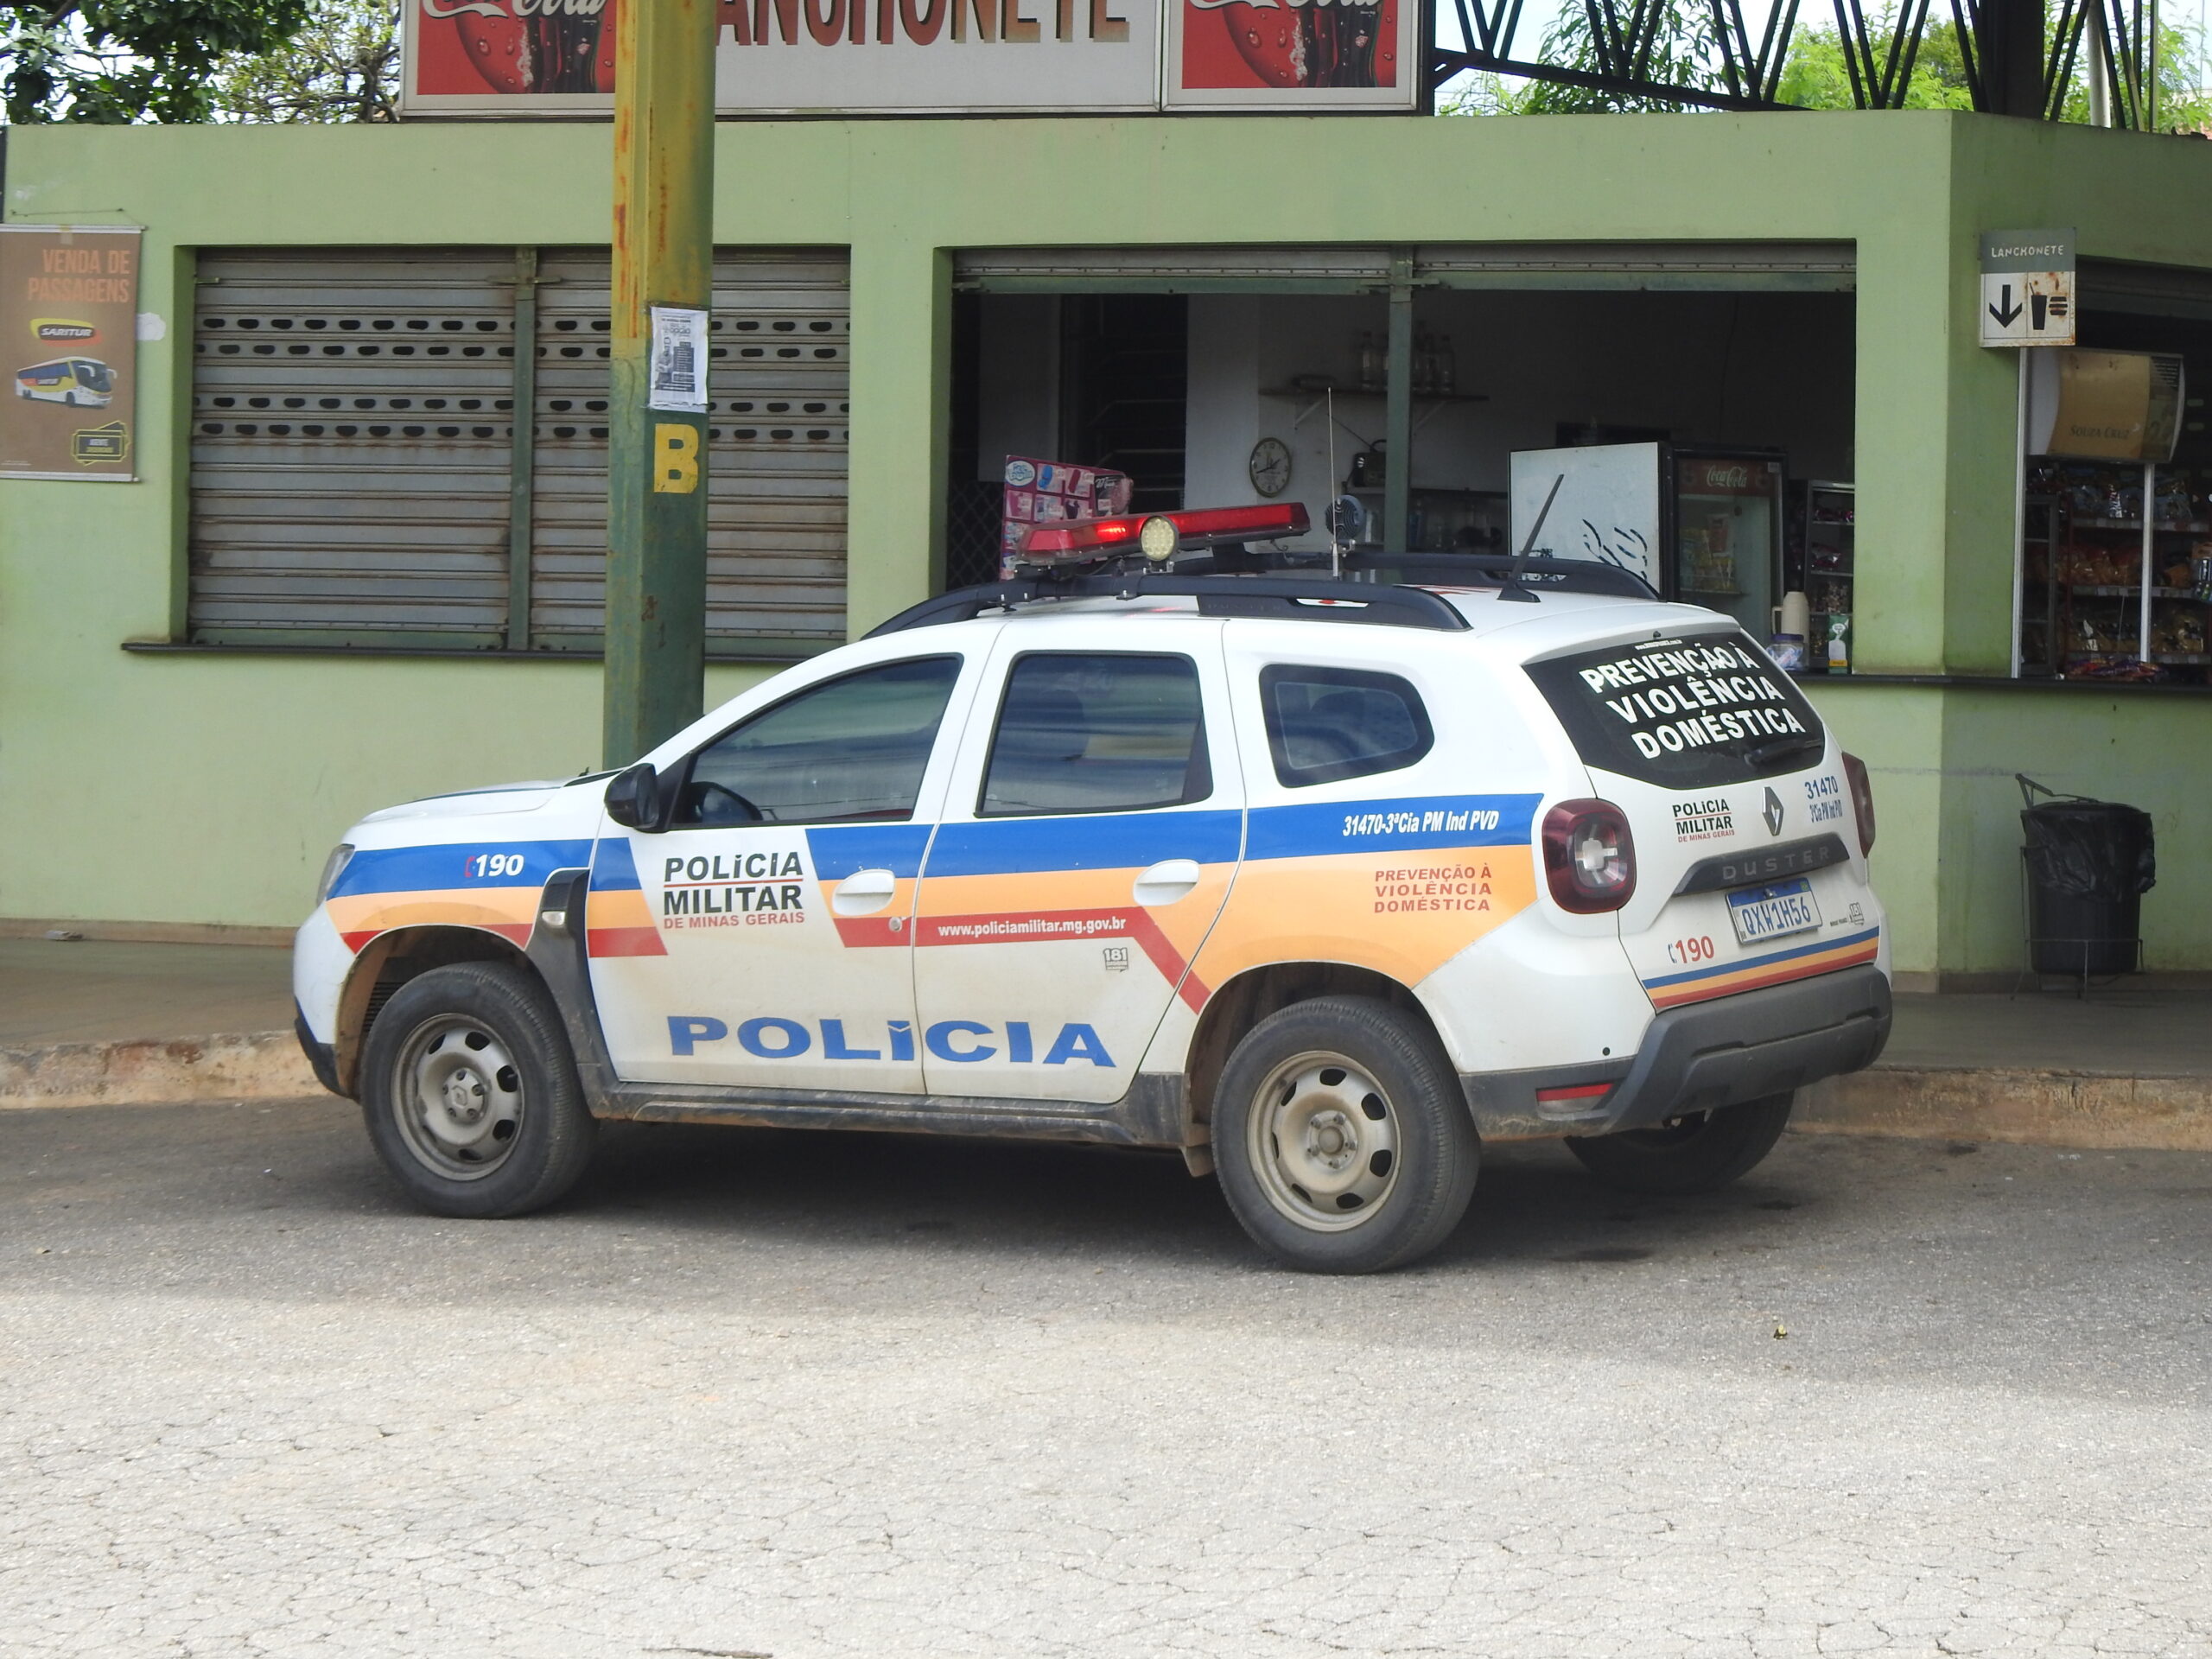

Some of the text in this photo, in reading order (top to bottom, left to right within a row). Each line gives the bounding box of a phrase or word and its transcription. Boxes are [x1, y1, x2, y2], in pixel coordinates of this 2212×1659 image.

[43, 249, 130, 275] VENDA DE
[1991, 245, 2064, 258] LANCHONETE
[28, 276, 130, 303] PASSAGENS
[41, 327, 92, 337] SARITUR
[654, 423, 699, 494] B
[1579, 642, 1738, 694] PREVENÇÃO
[1605, 675, 1786, 724] VIOLÊNCIA
[1631, 707, 1807, 760] DOMÉSTICA
[1804, 775, 1839, 799] 31470
[1421, 810, 1445, 833] PM
[1445, 810, 1470, 831] Ind
[1469, 810, 1501, 831] PVD
[1675, 816, 1733, 836] MILITAR
[1689, 832, 1712, 842] MINAS
[1713, 829, 1736, 838] GERAIS
[475, 854, 525, 878] 190
[1375, 862, 1492, 883] PREVENÇÃO À
[1722, 846, 1830, 880] DUSTER
[664, 884, 804, 916] MILITAR
[1375, 880, 1492, 898] VIOLÊNCIA
[1374, 896, 1491, 914] DOMÉSTICA
[664, 912, 805, 930] DE MINAS GERAIS
[938, 916, 1127, 938] www.policiamilitar.mg.gov.br
[1103, 947, 1128, 962] 181
[1675, 935, 1715, 964] 190
